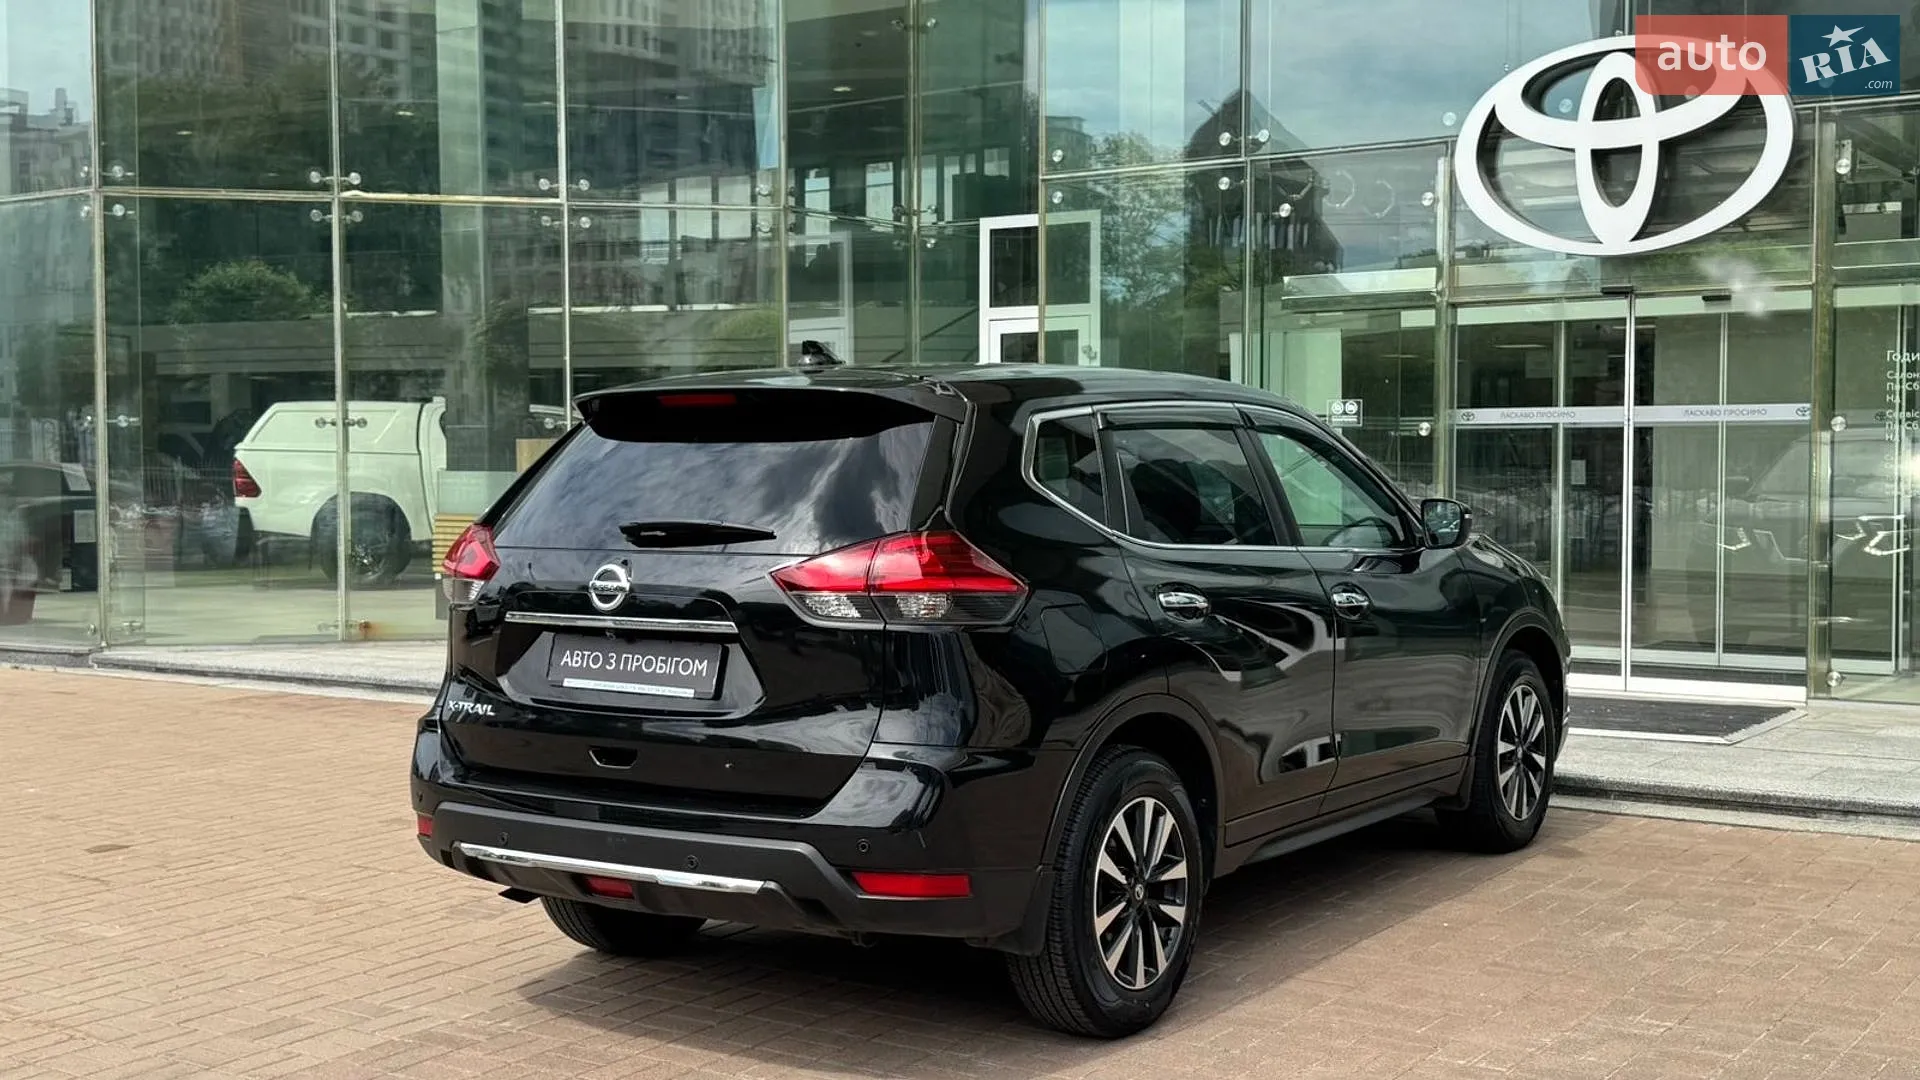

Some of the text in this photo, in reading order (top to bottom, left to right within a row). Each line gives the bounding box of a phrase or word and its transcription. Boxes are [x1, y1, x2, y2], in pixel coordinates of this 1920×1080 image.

[560, 650, 603, 669] АВТО
[620, 654, 708, 677] ПРОБІГОМ
[449, 700, 496, 716] X-TRAIL
